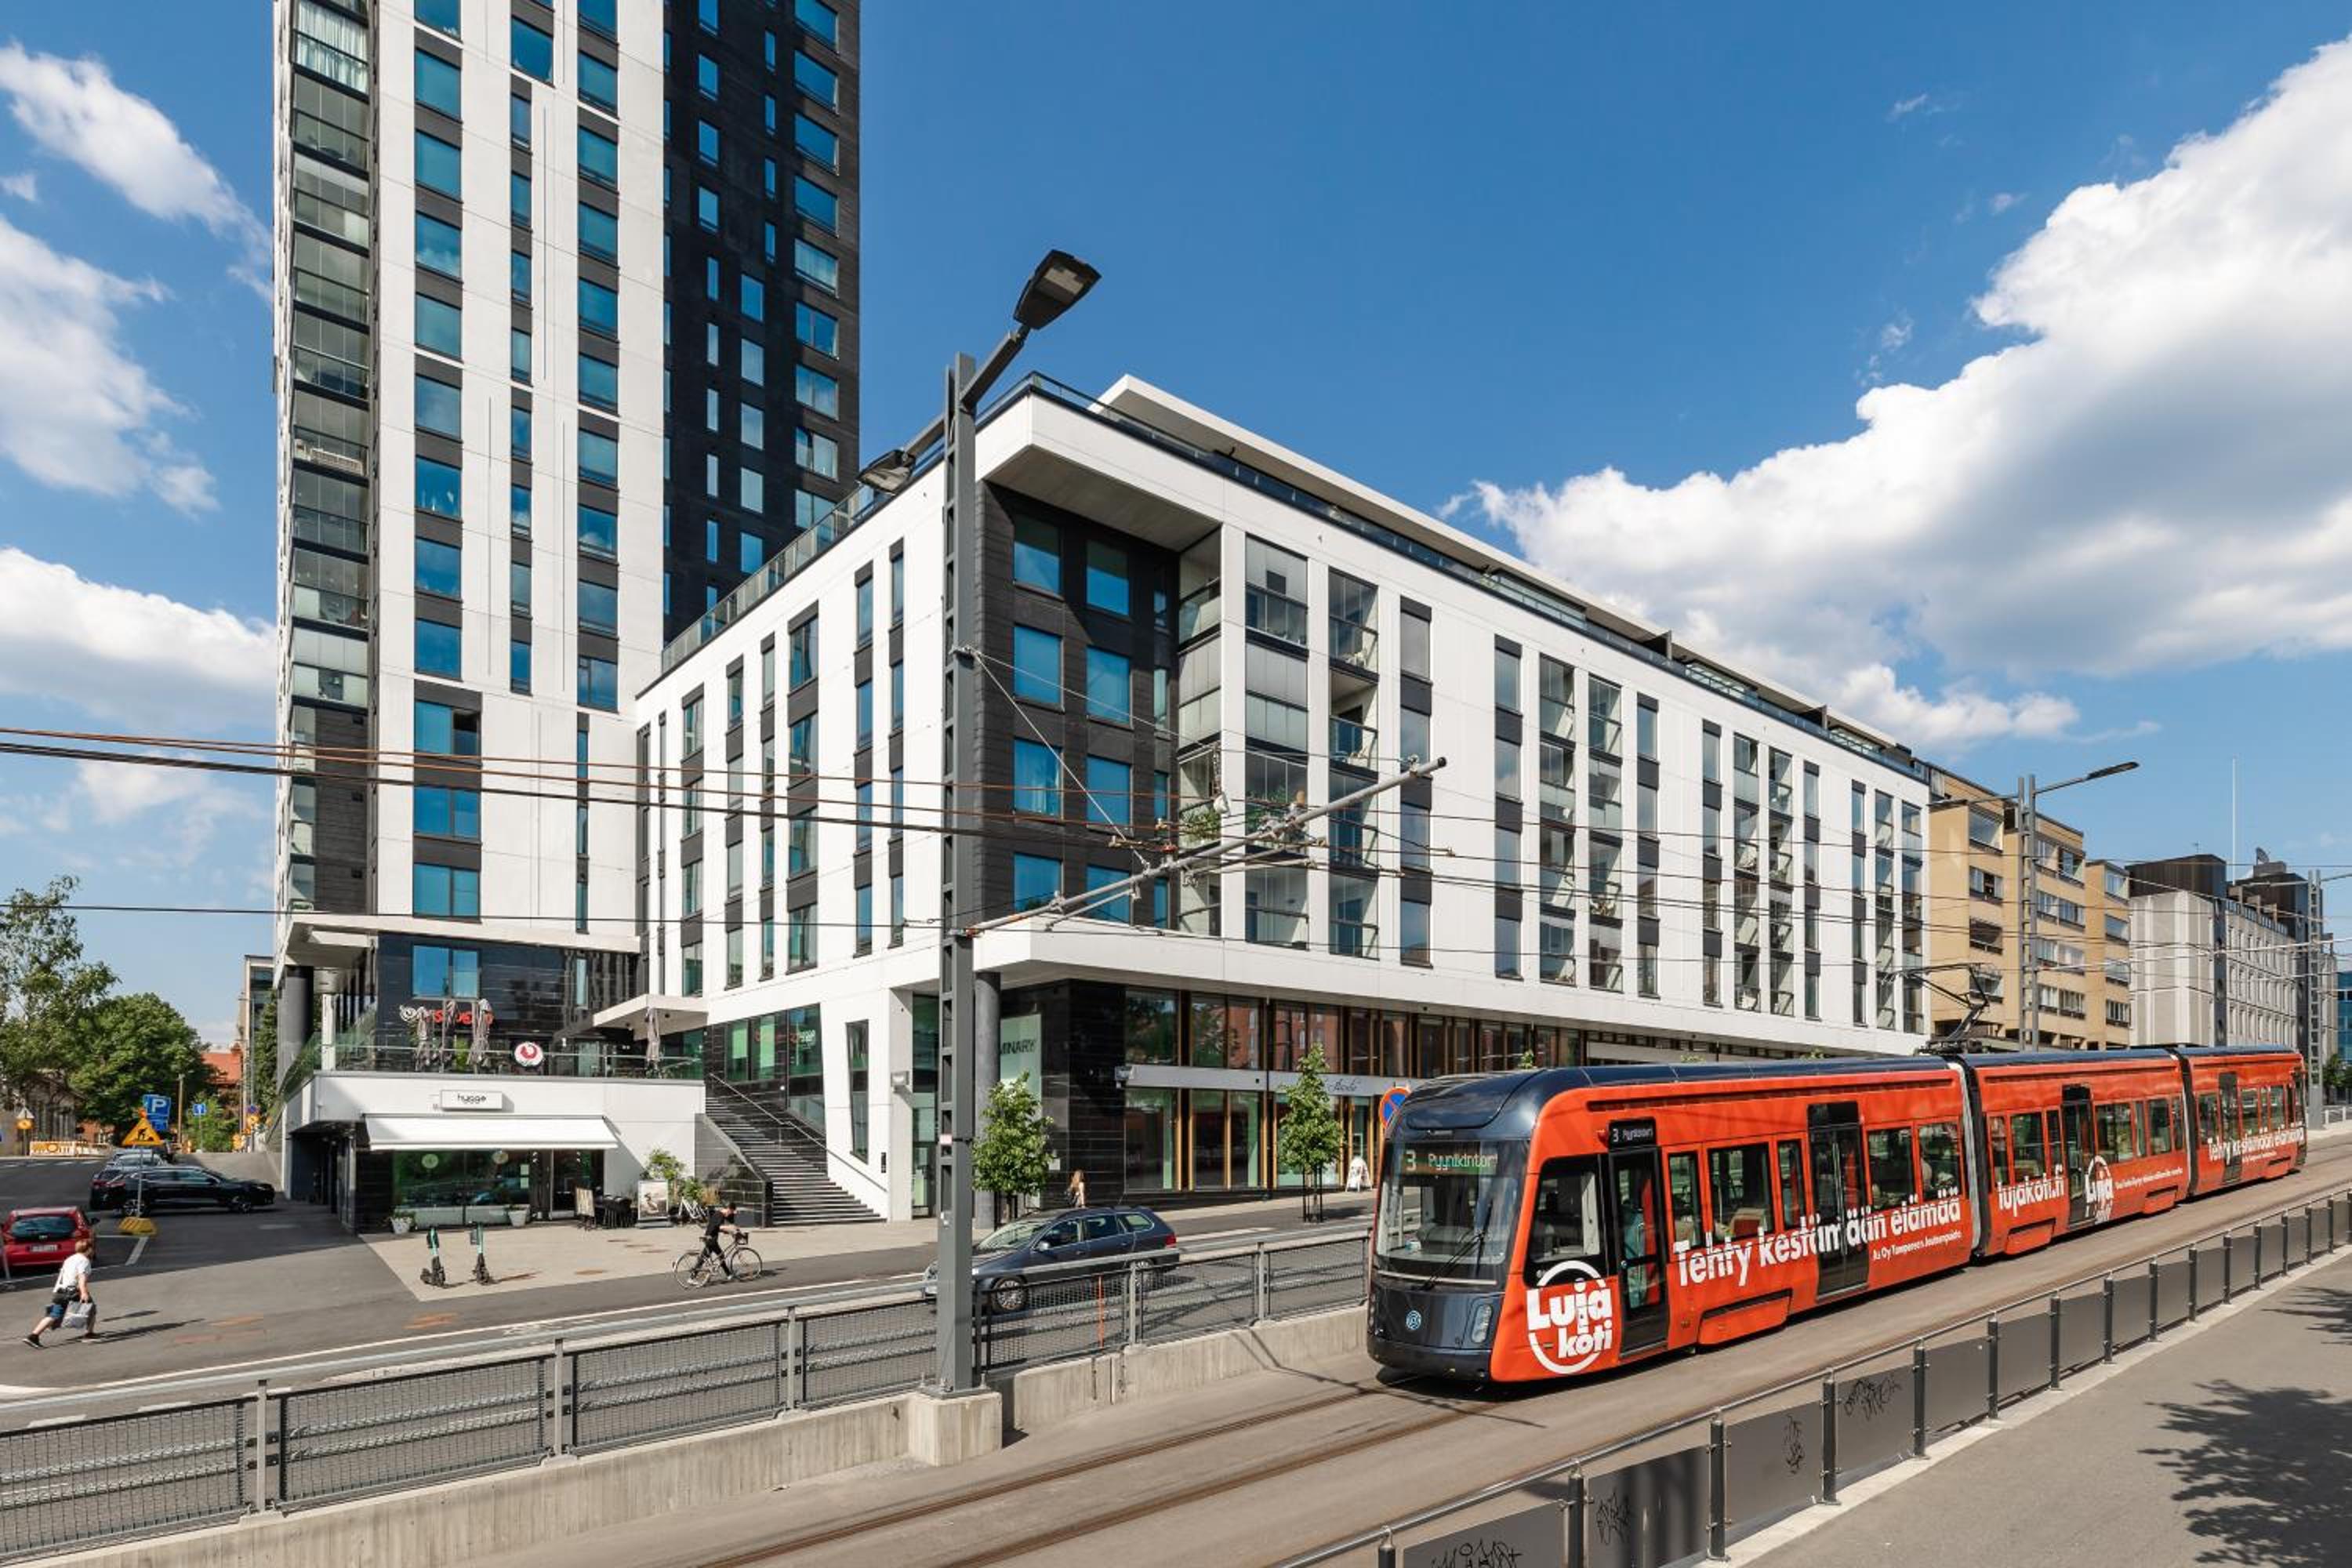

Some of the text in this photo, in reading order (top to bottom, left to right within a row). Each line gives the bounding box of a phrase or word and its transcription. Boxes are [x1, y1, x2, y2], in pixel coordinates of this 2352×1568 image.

[1001, 1039, 1036, 1054] INARY
[151, 1098, 167, 1112] P
[457, 1093, 487, 1105] hygge
[1613, 1128, 1619, 1142] 3
[1406, 1149, 1417, 1172] 3
[1997, 1163, 2064, 1217] lujakoti.fi
[1673, 1186, 1961, 1287] Tehty kestämään elämää
[1526, 1277, 1613, 1334] Luja
[1558, 1319, 1613, 1359] koti
